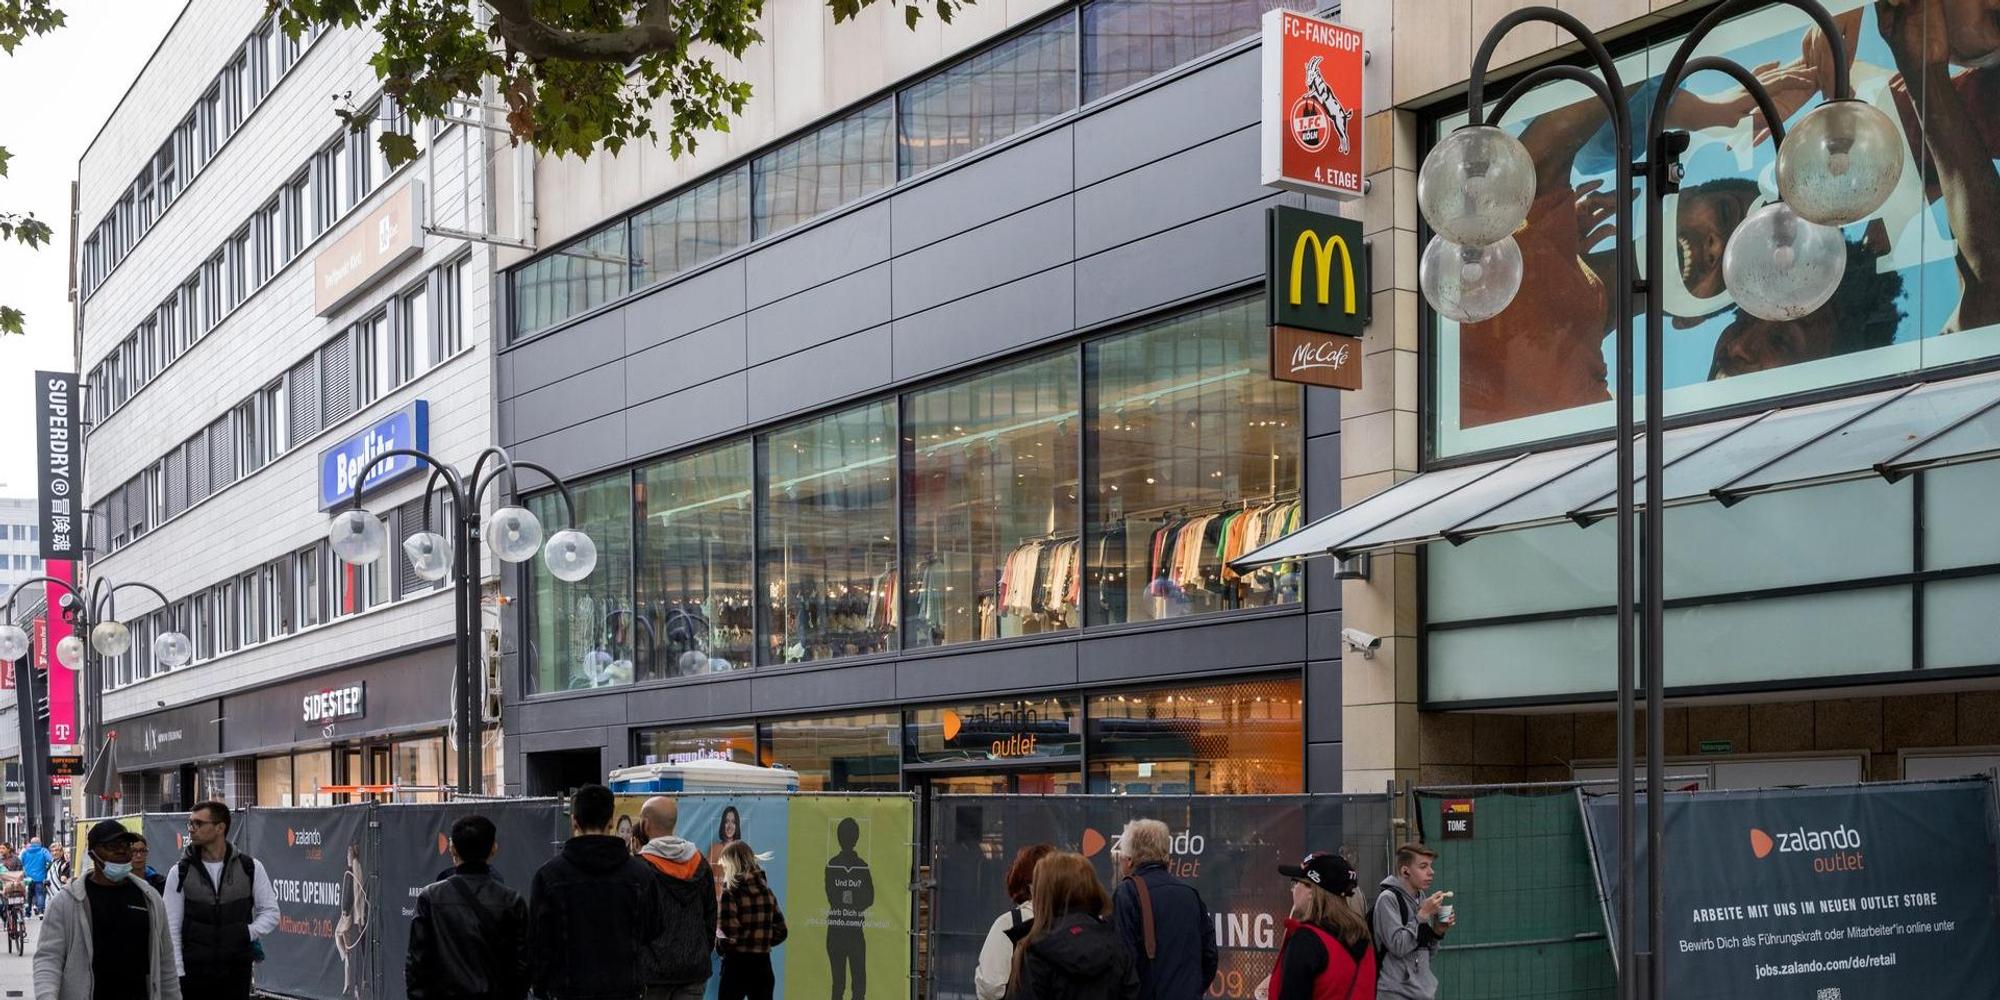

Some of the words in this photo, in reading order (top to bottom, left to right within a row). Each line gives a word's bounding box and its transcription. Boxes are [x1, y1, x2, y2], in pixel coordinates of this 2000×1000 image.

[1284, 16, 1361, 53] FC-FANSHOP
[1314, 166, 1325, 183] 4.
[1327, 168, 1358, 189] ETAGE
[1291, 340, 1350, 373] McCafé
[336, 430, 395, 495] Berlitz
[303, 686, 361, 722] SIDESTEP
[991, 733, 1037, 757] outlet
[295, 828, 321, 845] zalando
[1447, 820, 1467, 832] TOME
[1776, 824, 1861, 852] zalando
[1111, 829, 1205, 856] zndo
[1814, 851, 1864, 873] outlet
[273, 878, 300, 902] STORE
[302, 880, 340, 906] OPENING
[1693, 906, 1744, 922] ARBEITE
[1747, 904, 1768, 919] MIT
[1773, 902, 1797, 917] UNS
[1800, 901, 1815, 915] IM
[1820, 898, 1857, 913] NEUEN
[1860, 894, 1900, 911] OUTLET
[1903, 892, 1938, 907] STORE
[1679, 937, 1715, 952] Bewirb
[1717, 936, 1740, 949] Dich
[1742, 934, 1757, 948] als
[1758, 929, 1822, 946] Führungskraft
[1824, 928, 1845, 941] oder
[1906, 920, 1932, 934] online
[1933, 919, 1956, 932] unter
[1755, 952, 1897, 980] jobs.zalando.com/de/retail
